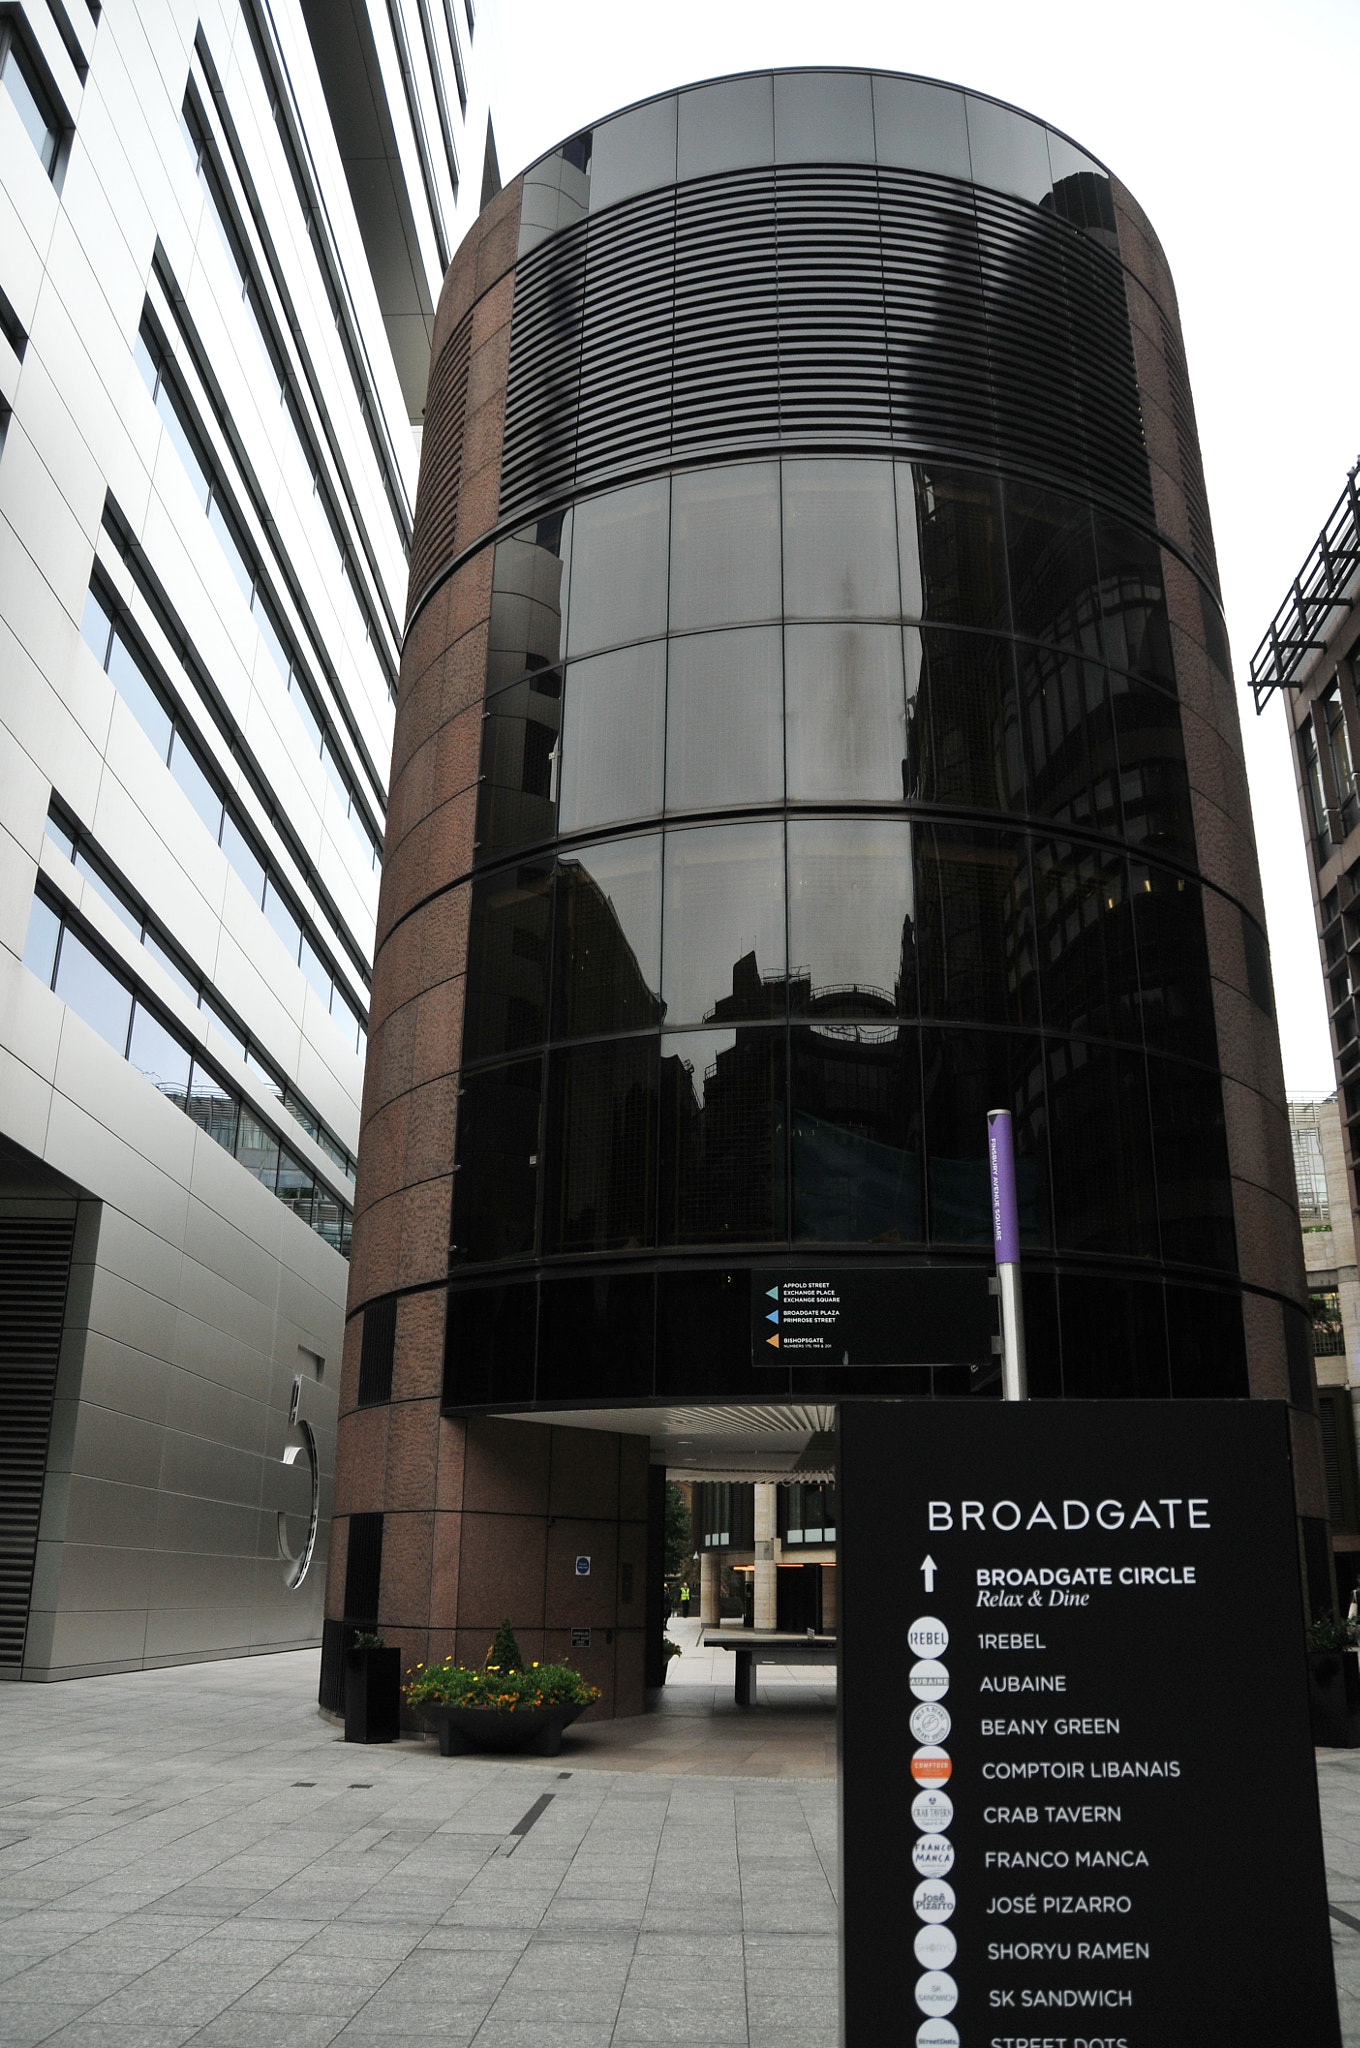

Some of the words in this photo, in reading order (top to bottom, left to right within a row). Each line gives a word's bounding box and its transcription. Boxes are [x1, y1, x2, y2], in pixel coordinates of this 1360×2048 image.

[994, 1208, 1002, 1242] SQUARE
[928, 1498, 1212, 1533] BROADGATE
[976, 1567, 1113, 1587] BROADGATE
[1118, 1566, 1197, 1586] CIRCLE
[976, 1589, 1024, 1608] Relax
[1027, 1589, 1043, 1607] &
[1048, 1589, 1090, 1607] Dine
[977, 1633, 1047, 1650] 1REBEL
[979, 1675, 1067, 1693] AUBAINE
[981, 1719, 1048, 1737] BEANY
[1053, 1717, 1120, 1735] GREEN
[982, 1761, 1085, 1780] COMPTOIR
[1090, 1760, 1181, 1778] LIBANAIS
[983, 1806, 1039, 1824] CRAB
[1044, 1805, 1122, 1823] TAVERN
[914, 1843, 953, 1852] FRANCO
[915, 1854, 951, 1863] MANCA
[985, 1851, 1070, 1869] FRANCO
[1075, 1850, 1150, 1868] MANCA
[915, 1901, 954, 1911] Pizarro
[922, 1892, 946, 1903] José
[986, 1892, 1037, 1914] JOSÉ
[1043, 1895, 1132, 1914] PIZARRO
[987, 1942, 1071, 1961] SHORYU
[1077, 1942, 1150, 1960] RAMEN
[917, 1994, 956, 2002] SANDWICH
[989, 1989, 1015, 2008] SK
[1021, 1989, 1132, 2008] SANDWICH
[991, 2037, 1067, 2048] STREET
[1074, 2037, 1128, 2048] DOTS
